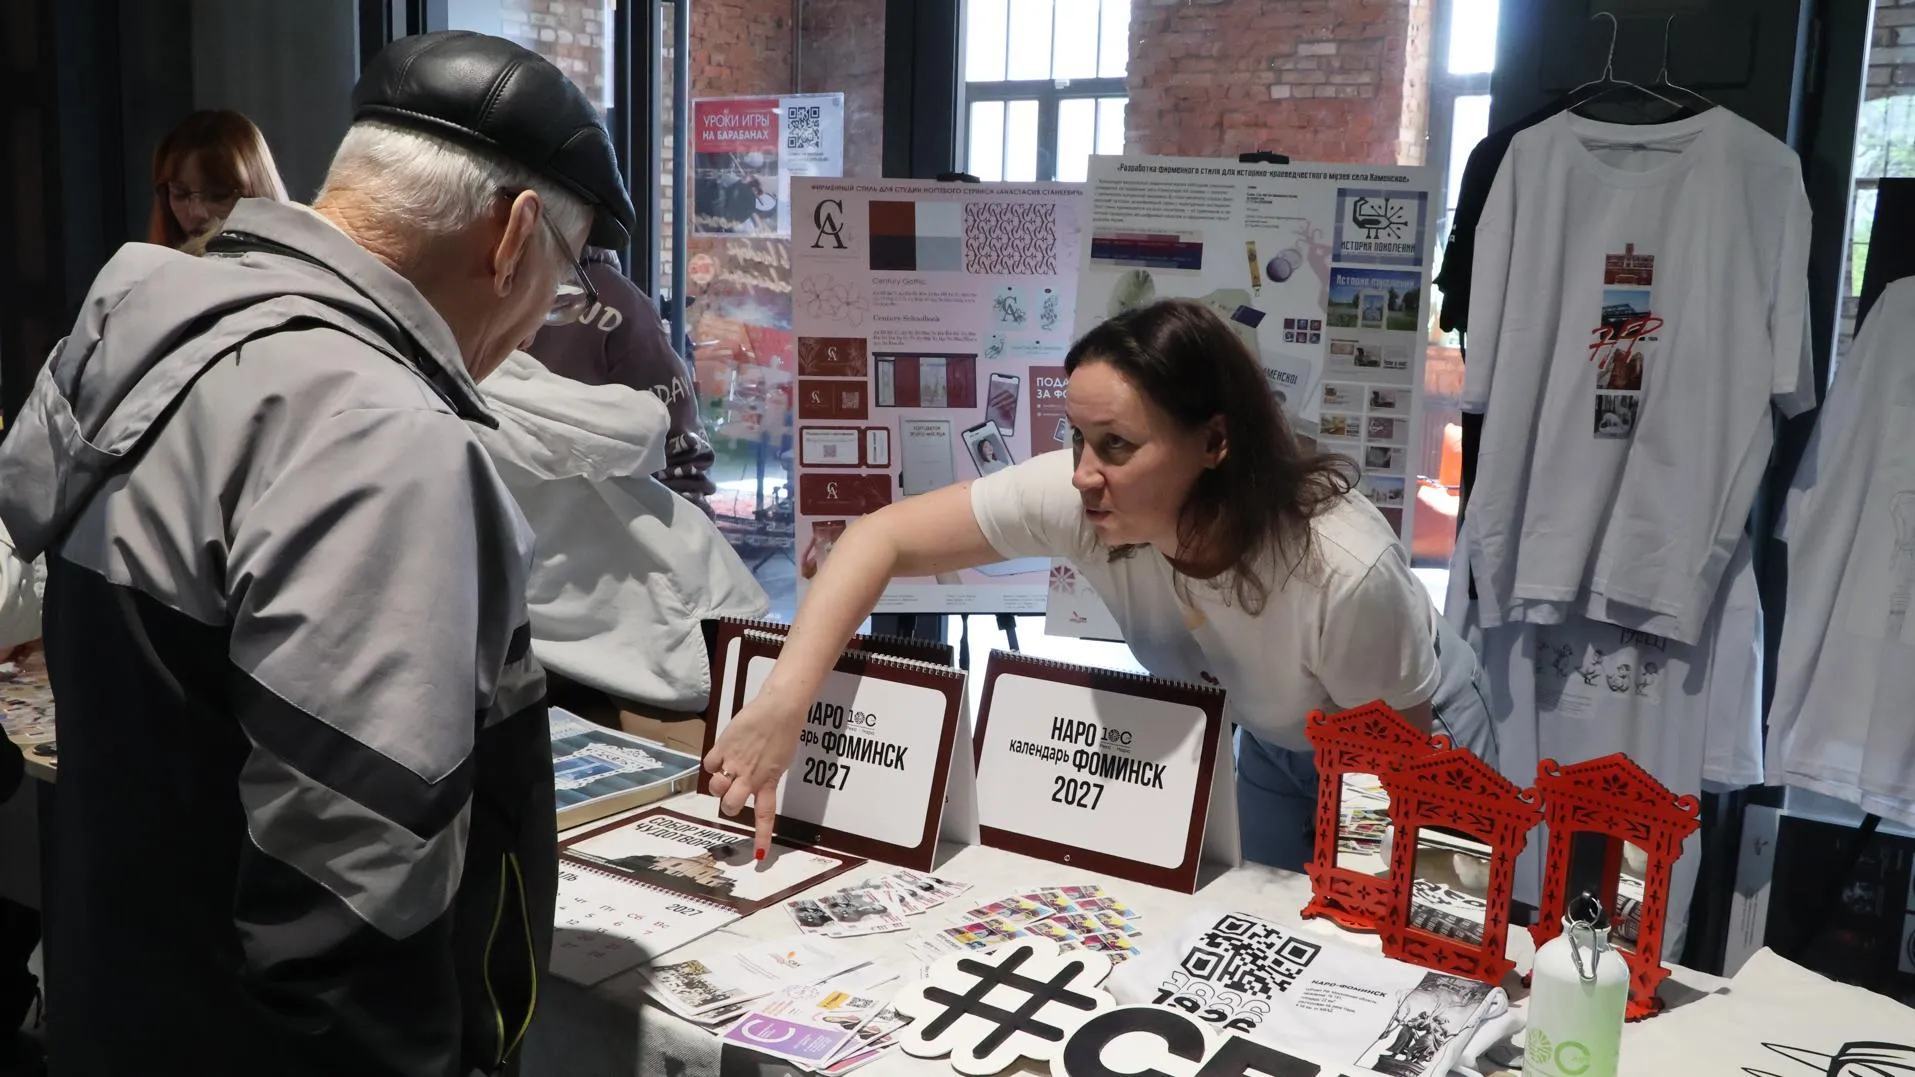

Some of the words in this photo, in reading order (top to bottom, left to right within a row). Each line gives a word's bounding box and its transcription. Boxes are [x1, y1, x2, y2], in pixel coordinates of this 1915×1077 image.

[703, 113, 739, 128] УРОКИ
[741, 114, 770, 127] ИГРЫ
[702, 130, 715, 141] НА
[717, 130, 769, 140] БАРАБАНАХ
[1200, 167, 1221, 175] стиля
[1222, 168, 1236, 176] для
[1352, 173, 1368, 181] села
[855, 185, 877, 193] СТИЛЬ
[895, 186, 922, 194] СТУДИИ
[1341, 240, 1372, 252] ИСТОРИЯ
[1036, 389, 1051, 399] ЗА
[807, 701, 844, 729] АРО
[1050, 716, 1097, 747] НАРО
[821, 731, 909, 771] ФОМИНСК
[1009, 739, 1070, 765] календарь
[1072, 749, 1167, 790] ФОМИНСК
[802, 757, 851, 791] 2027
[1051, 776, 1105, 810] 2027
[649, 817, 699, 833] СОБОР
[665, 903, 704, 917] 2027
[1312, 980, 1388, 998] НАРО-ФОМИНСК
